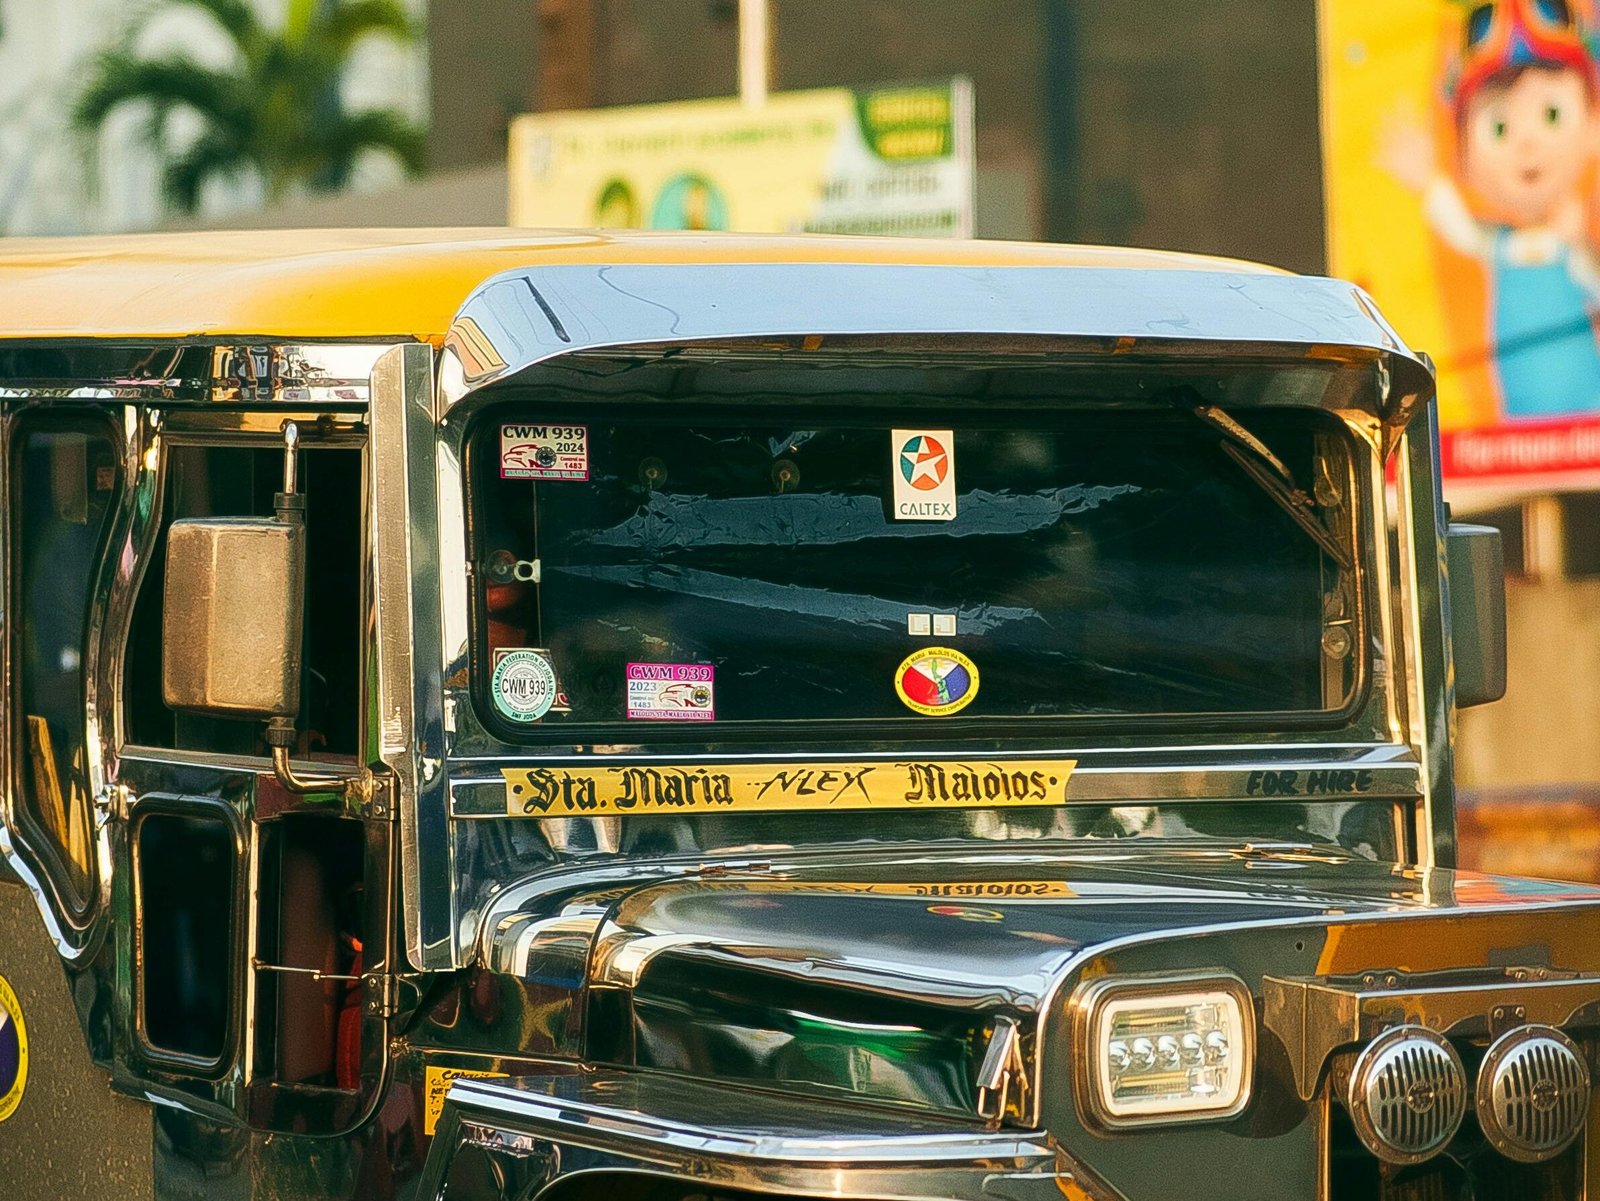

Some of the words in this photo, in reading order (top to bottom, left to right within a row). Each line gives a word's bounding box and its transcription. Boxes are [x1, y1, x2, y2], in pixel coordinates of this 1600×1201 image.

[503, 426, 548, 439] CWM
[552, 427, 585, 440] 939
[556, 442, 585, 452] 2024
[900, 502, 951, 516] CALTEX
[631, 666, 673, 679] CWM
[678, 668, 710, 680] 939
[502, 678, 527, 695] CWM
[529, 680, 546, 695] 939
[630, 681, 657, 691] 2023
[607, 767, 735, 811] Maria
[757, 766, 876, 804] NLEX
[1245, 769, 1300, 796] FOR
[1306, 769, 1373, 795] HIRE
